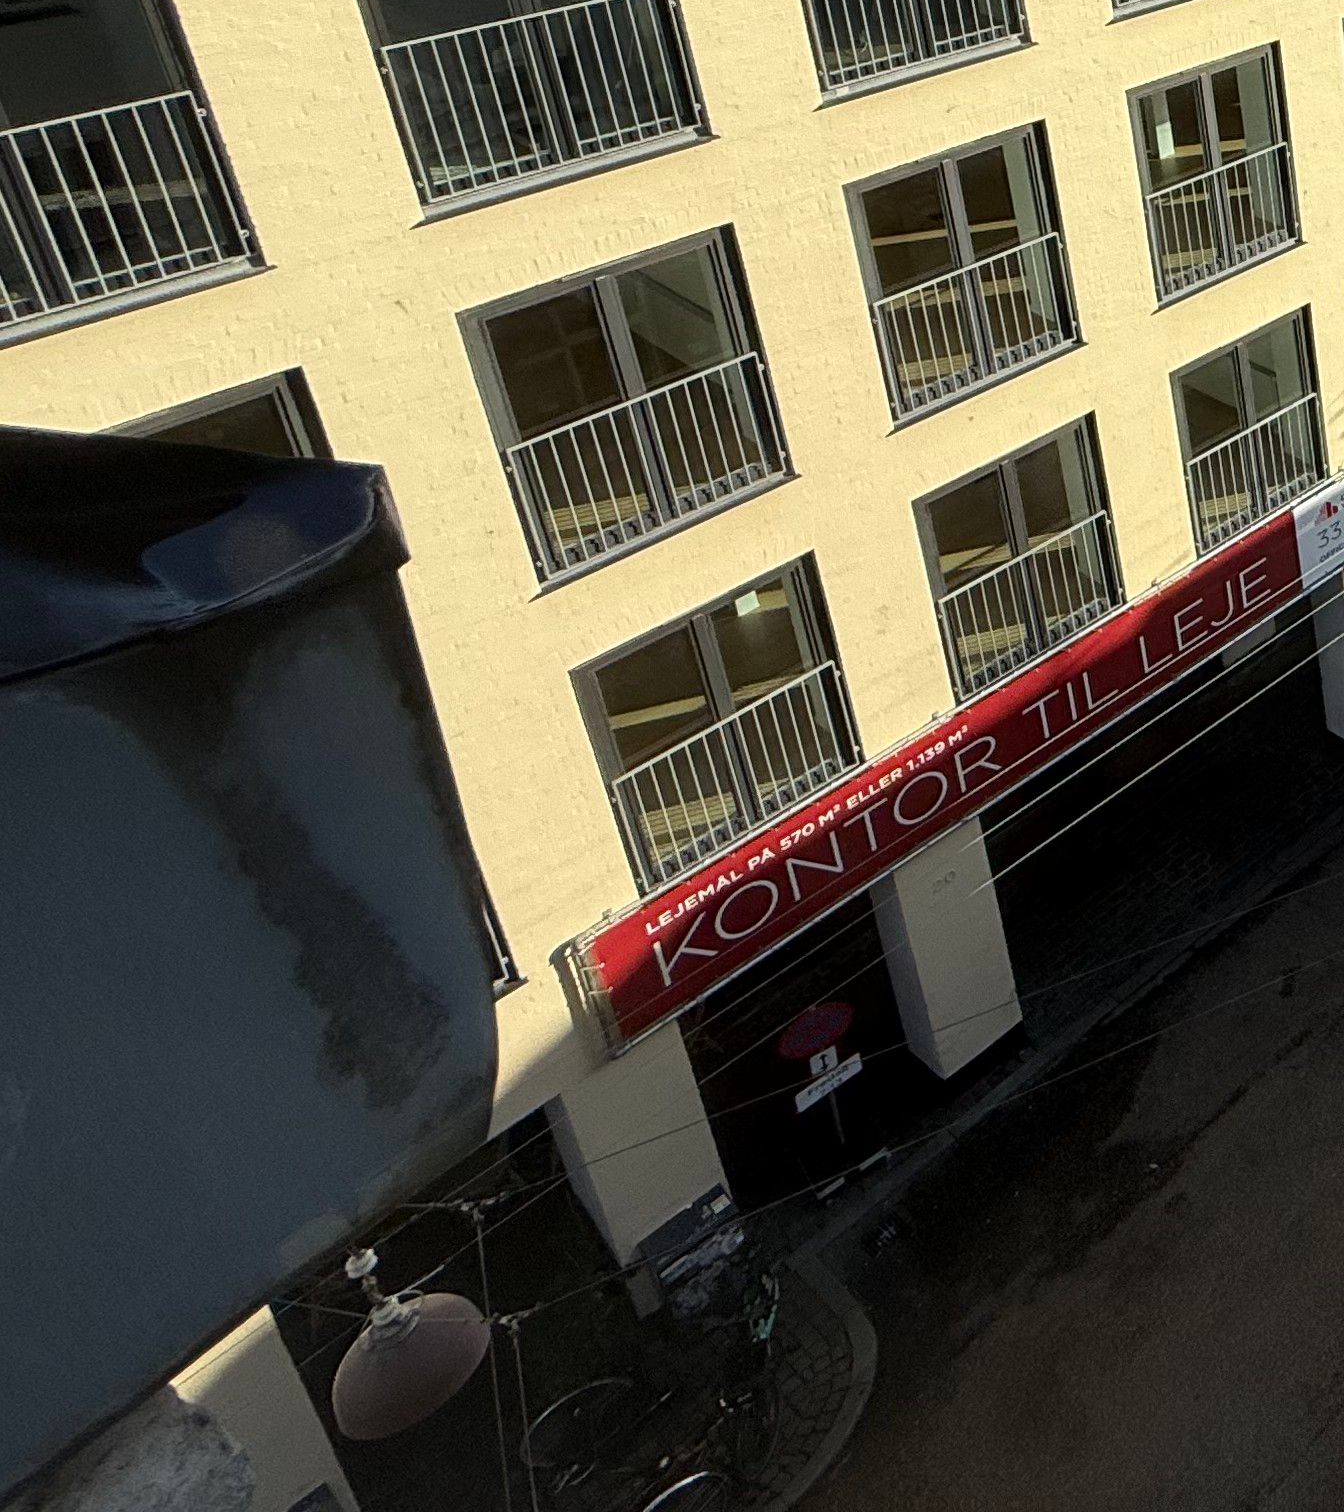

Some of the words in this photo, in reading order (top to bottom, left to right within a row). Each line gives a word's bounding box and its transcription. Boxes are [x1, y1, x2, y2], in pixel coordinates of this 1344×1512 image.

[1316, 520, 1342, 548] 33
[645, 870, 744, 935] LEJEMÅL
[748, 845, 777, 872] PÅ
[779, 822, 816, 850] 570
[846, 768, 904, 810] ELLER
[905, 743, 947, 772] 1.139
[651, 736, 1003, 987] KONTOR
[1022, 670, 1120, 740] TIL
[1137, 556, 1272, 674] LEJE
